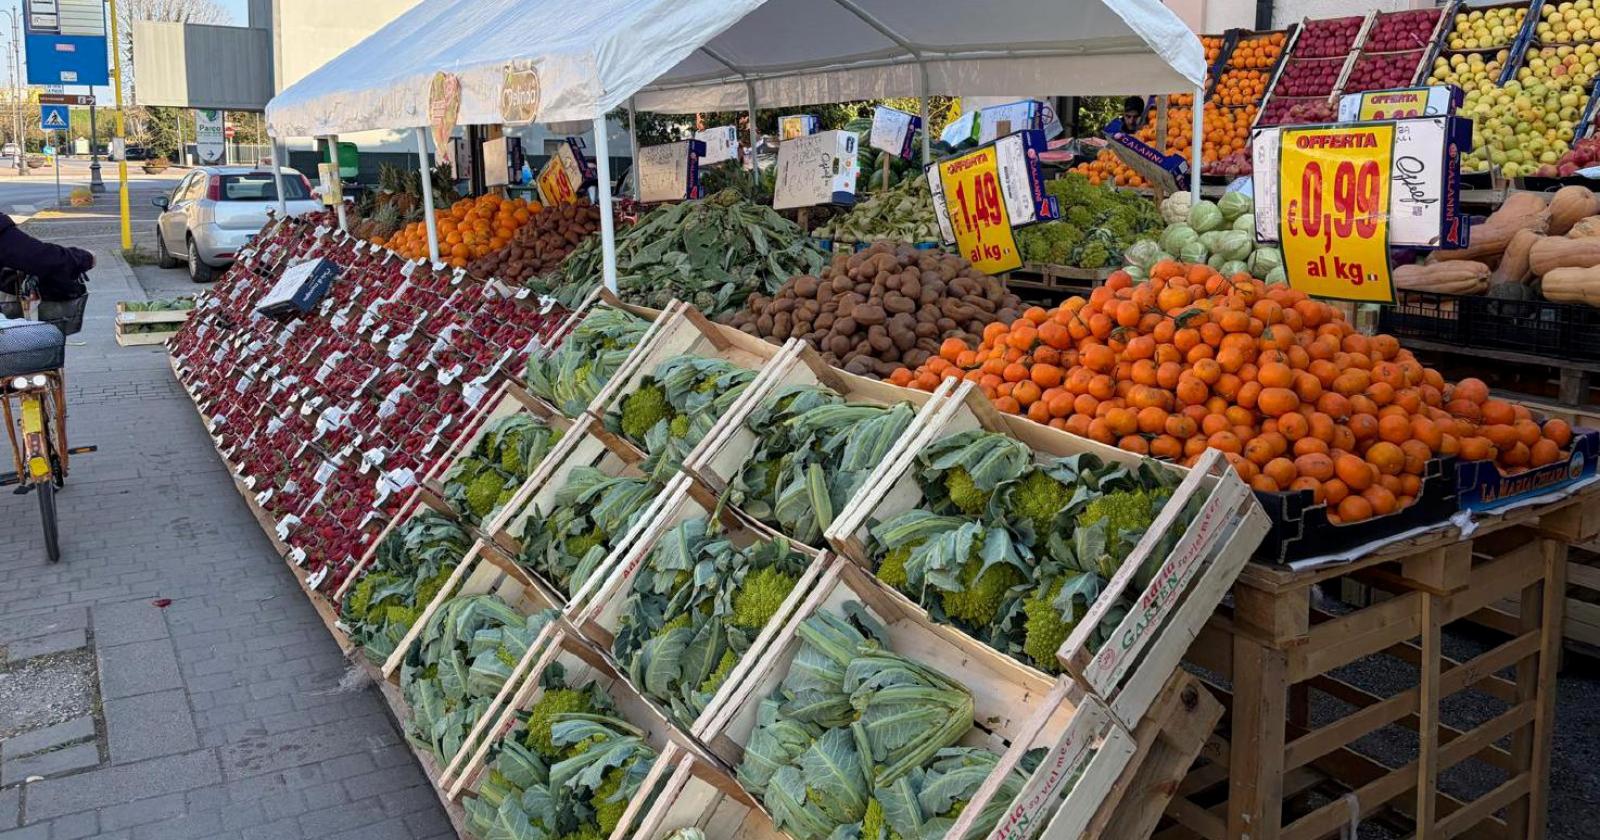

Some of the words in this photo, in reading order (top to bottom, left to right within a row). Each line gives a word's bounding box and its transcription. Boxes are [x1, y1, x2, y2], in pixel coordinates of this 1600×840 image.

[1370, 93, 1419, 105] OFFERTA
[1296, 132, 1378, 149] OFFERTA
[946, 152, 989, 175] OFFERTA
[970, 246, 982, 262] al
[983, 243, 1002, 261] kg
[1307, 254, 1327, 278] al
[1334, 256, 1365, 286] kg
[1142, 562, 1175, 609] Adria
[1121, 573, 1178, 649] GARTEN
